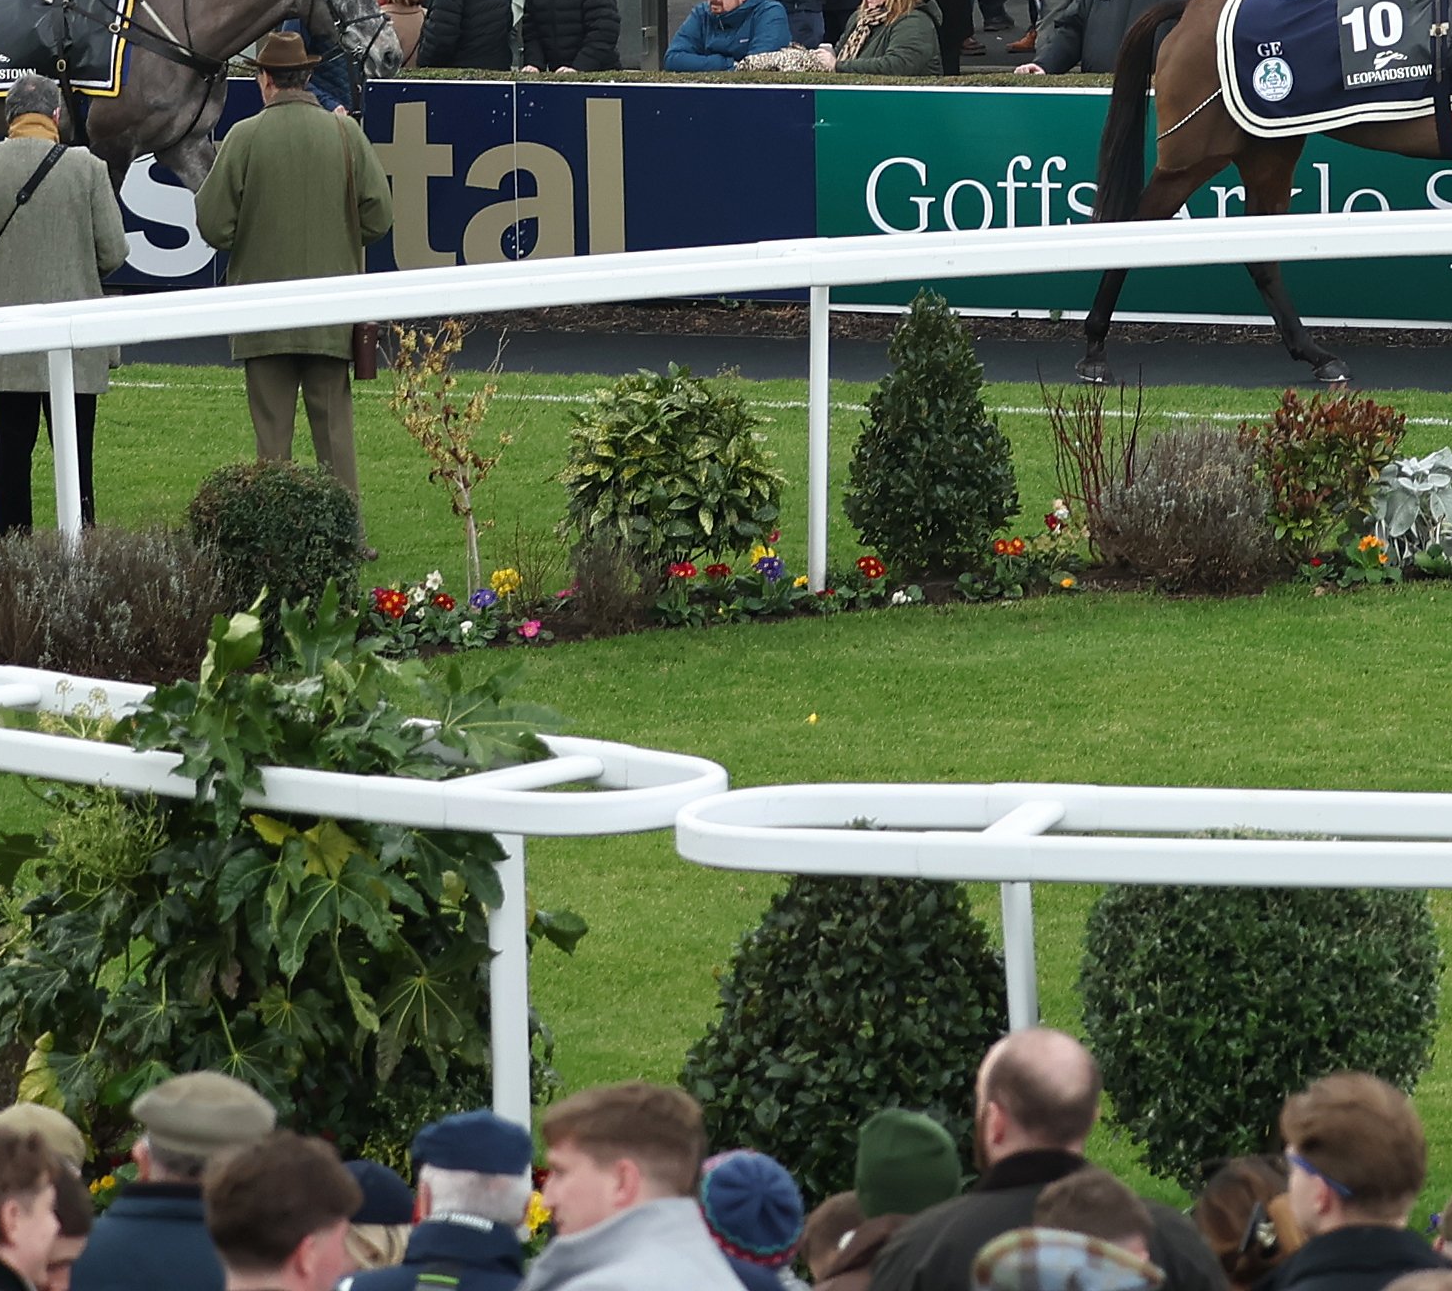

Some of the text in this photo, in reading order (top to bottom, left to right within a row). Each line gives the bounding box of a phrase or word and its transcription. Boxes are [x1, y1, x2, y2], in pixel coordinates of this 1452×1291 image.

[1257, 41, 1283, 57] GE
[1341, 1, 1403, 52] 10
[863, 155, 1098, 235] Goffs
